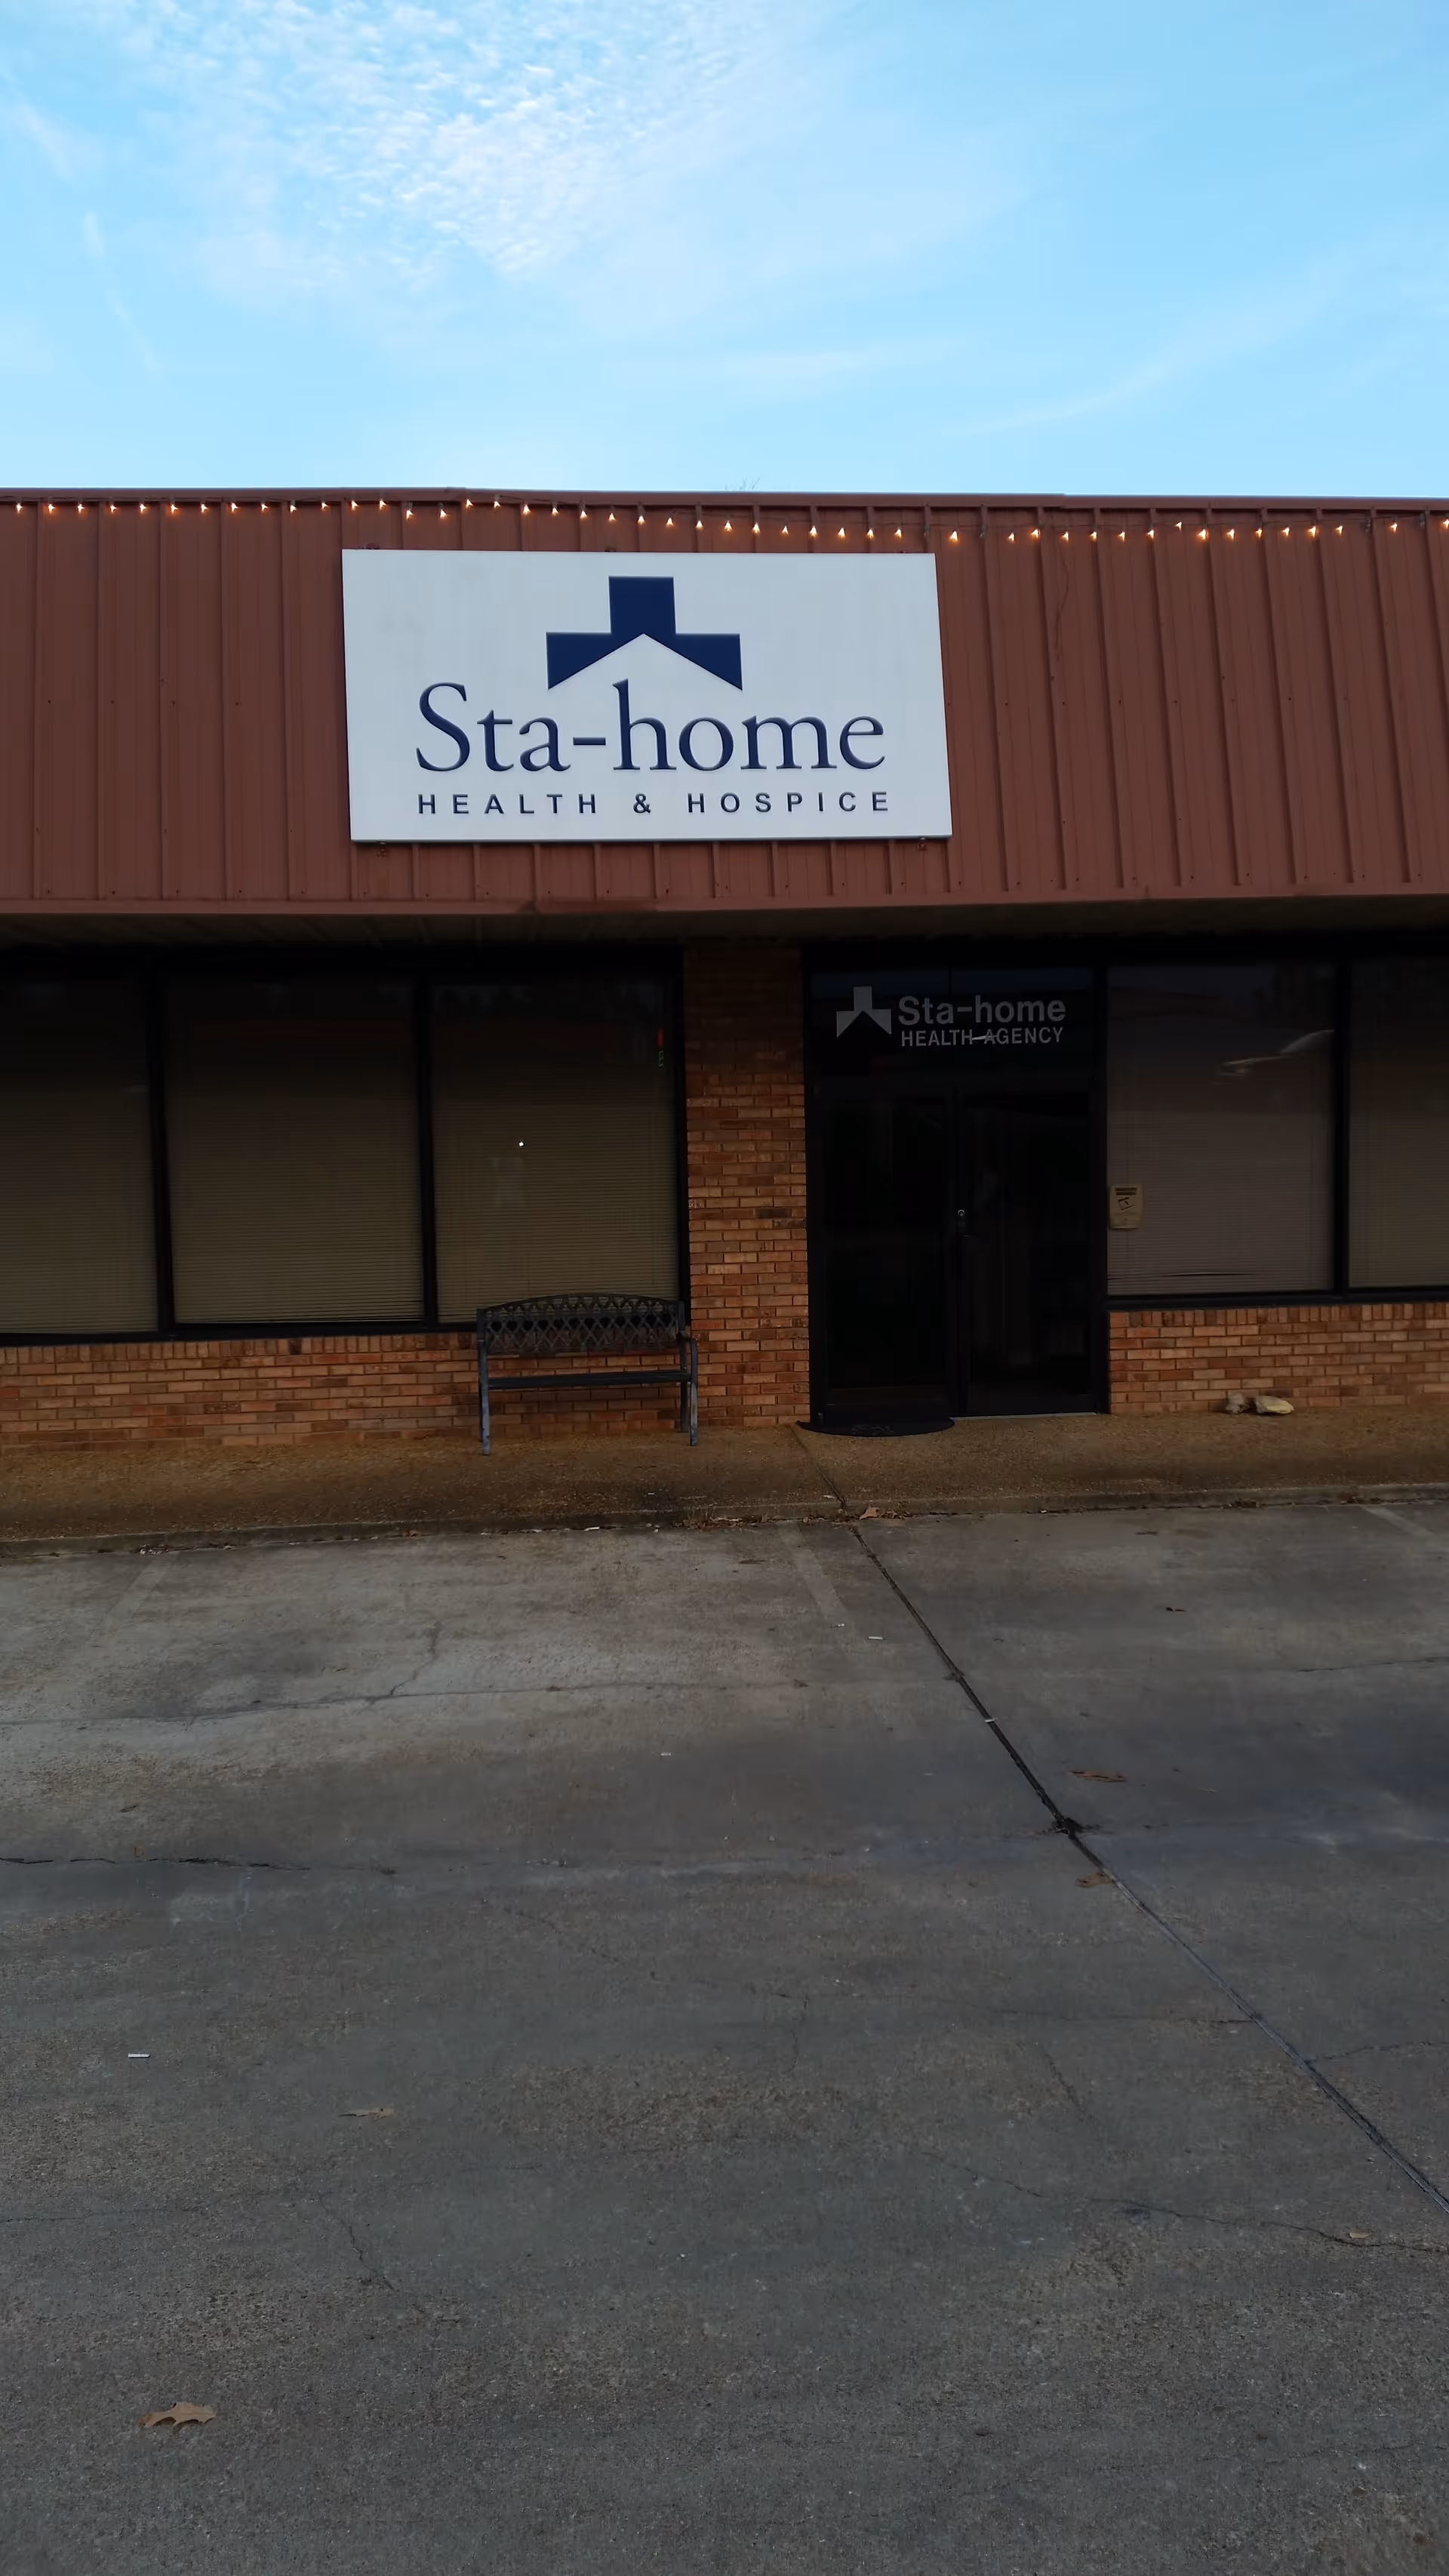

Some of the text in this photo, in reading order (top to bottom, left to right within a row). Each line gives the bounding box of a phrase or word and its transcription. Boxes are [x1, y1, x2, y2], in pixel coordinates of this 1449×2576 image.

[416, 679, 885, 772] Sta-home
[419, 792, 889, 814] HEALTH & HOSPICE
[898, 995, 1066, 1026] Sta-home
[901, 1026, 1063, 1047] HEALTH AGENCY
